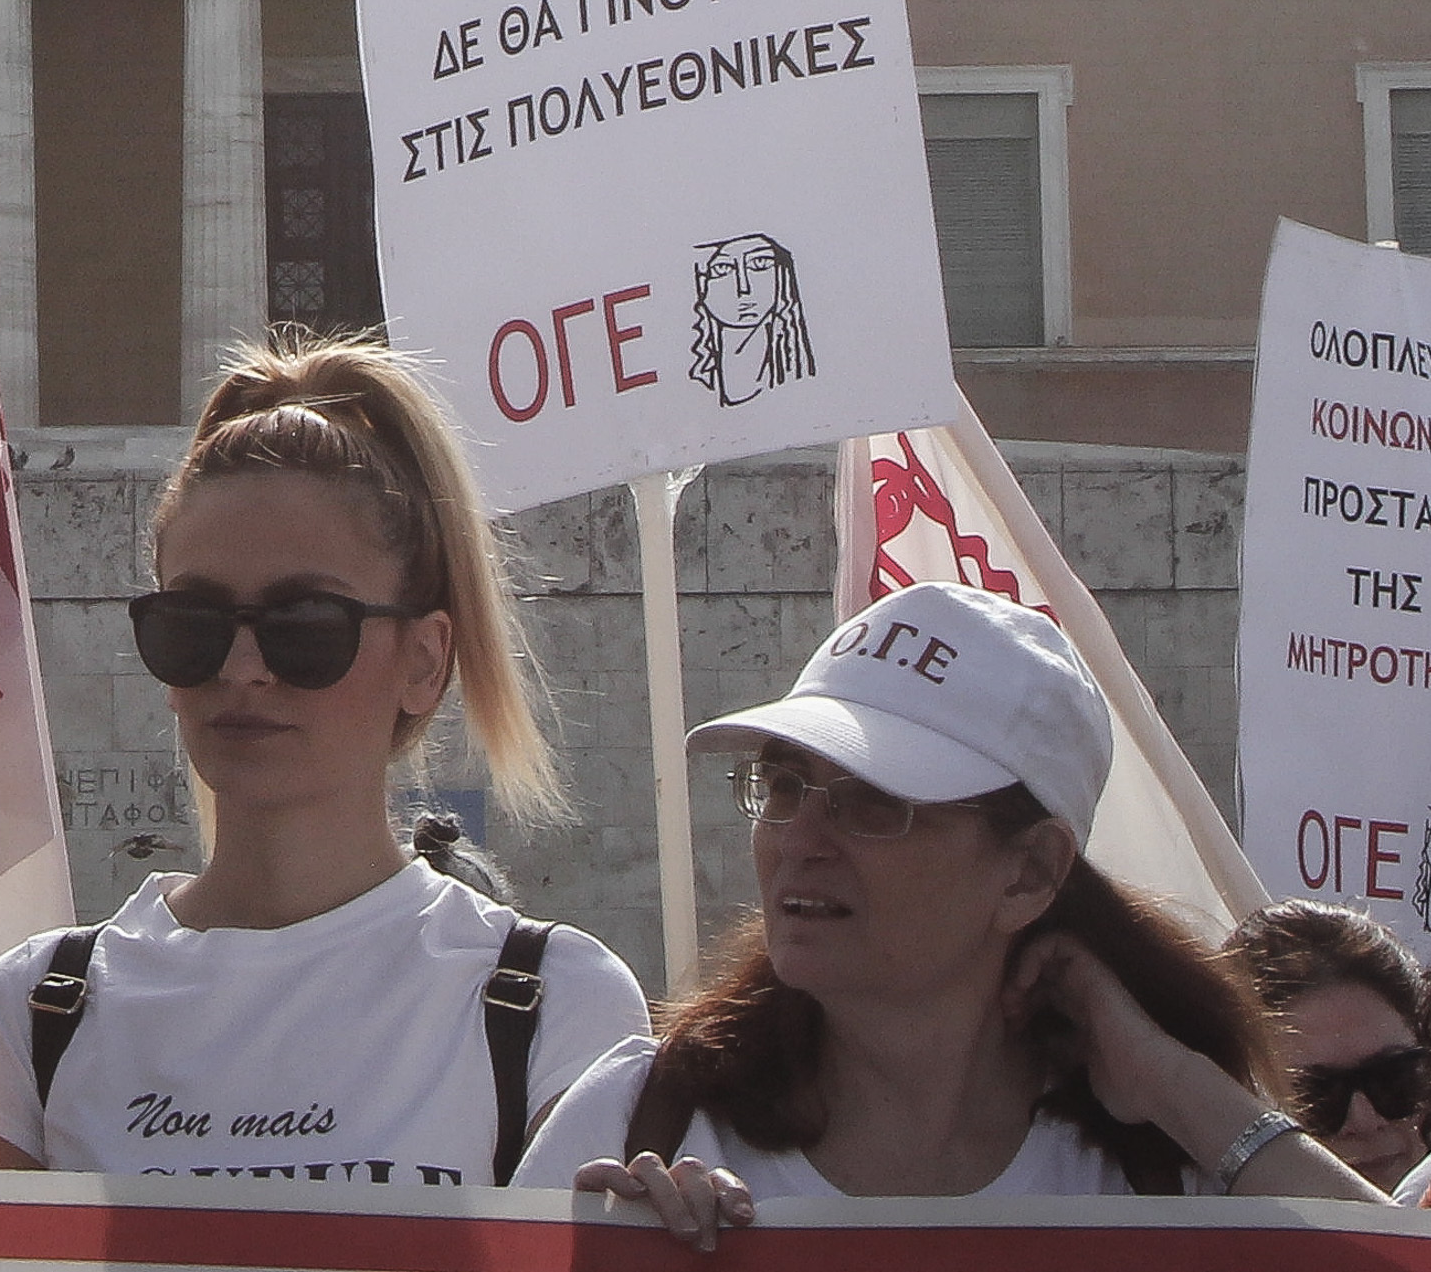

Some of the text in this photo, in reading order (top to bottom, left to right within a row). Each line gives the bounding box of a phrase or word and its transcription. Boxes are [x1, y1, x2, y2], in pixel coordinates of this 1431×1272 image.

[432, 18, 485, 81] ΔΕ
[400, 16, 876, 184] ΣΤΙΣ ΠΟΛΥΕΘΝΙΚΕΣ
[488, 283, 659, 423] ΟΓΕ
[1345, 567, 1423, 614] ΤΗΣ
[1296, 809, 1410, 901] ΟΓΕ
[126, 1092, 338, 1139] Non mais
